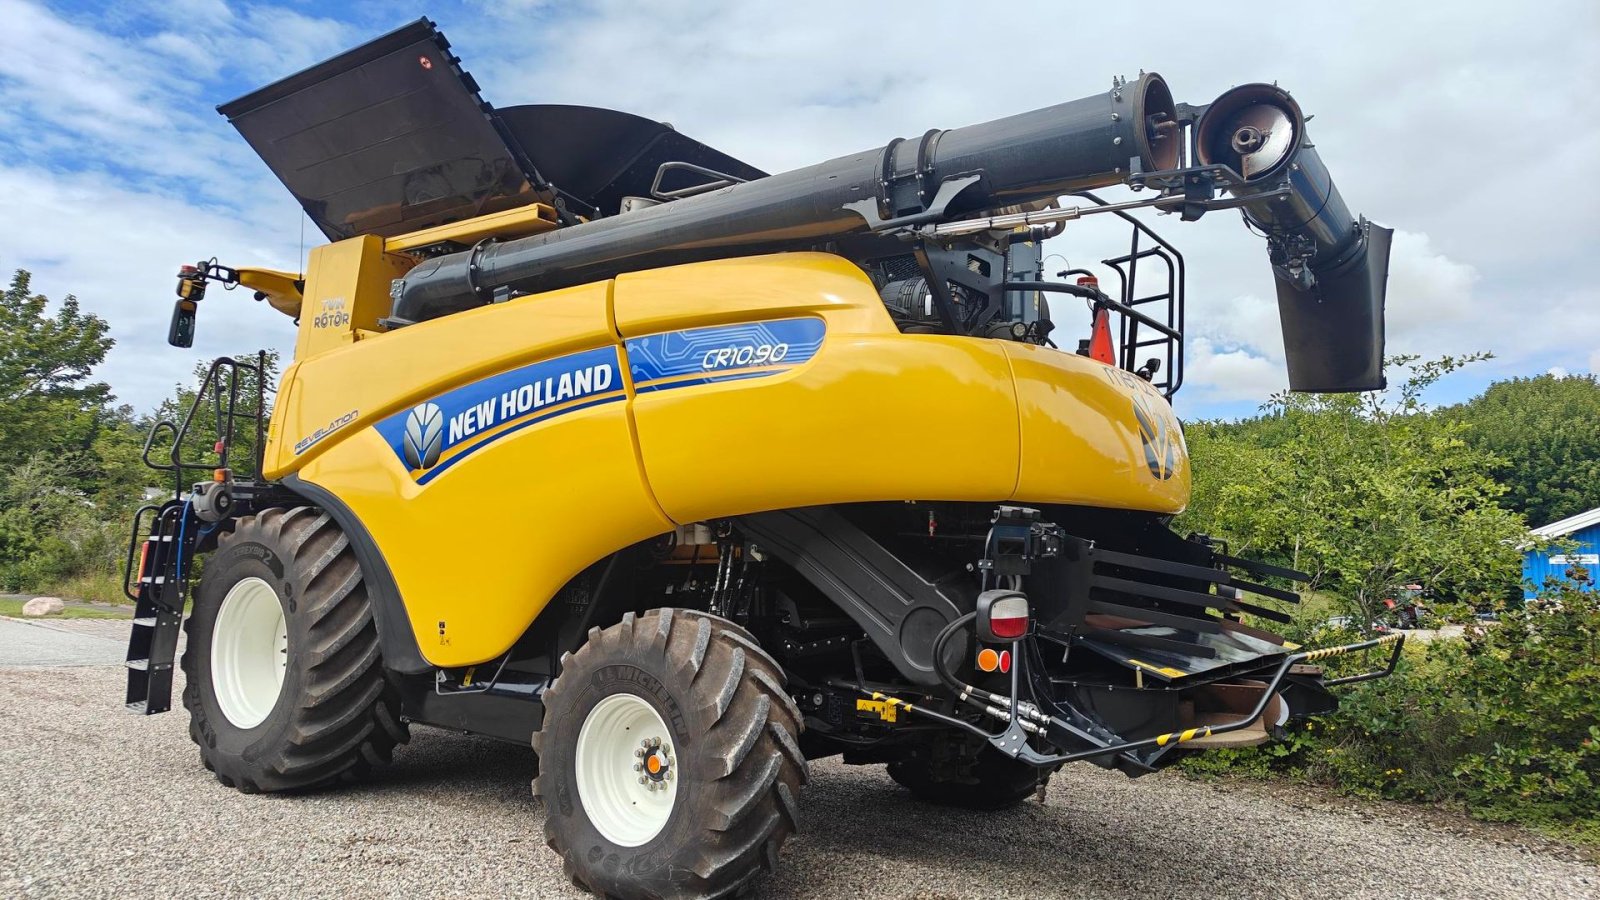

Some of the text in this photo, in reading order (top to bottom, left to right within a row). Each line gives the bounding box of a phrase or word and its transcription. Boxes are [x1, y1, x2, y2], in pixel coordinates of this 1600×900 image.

[321, 297, 345, 311] TWIN
[313, 311, 350, 329] ROTOR
[702, 342, 789, 369] CR10.90
[448, 363, 613, 445] NEW HOLLAND
[294, 409, 359, 452] REVELATION
